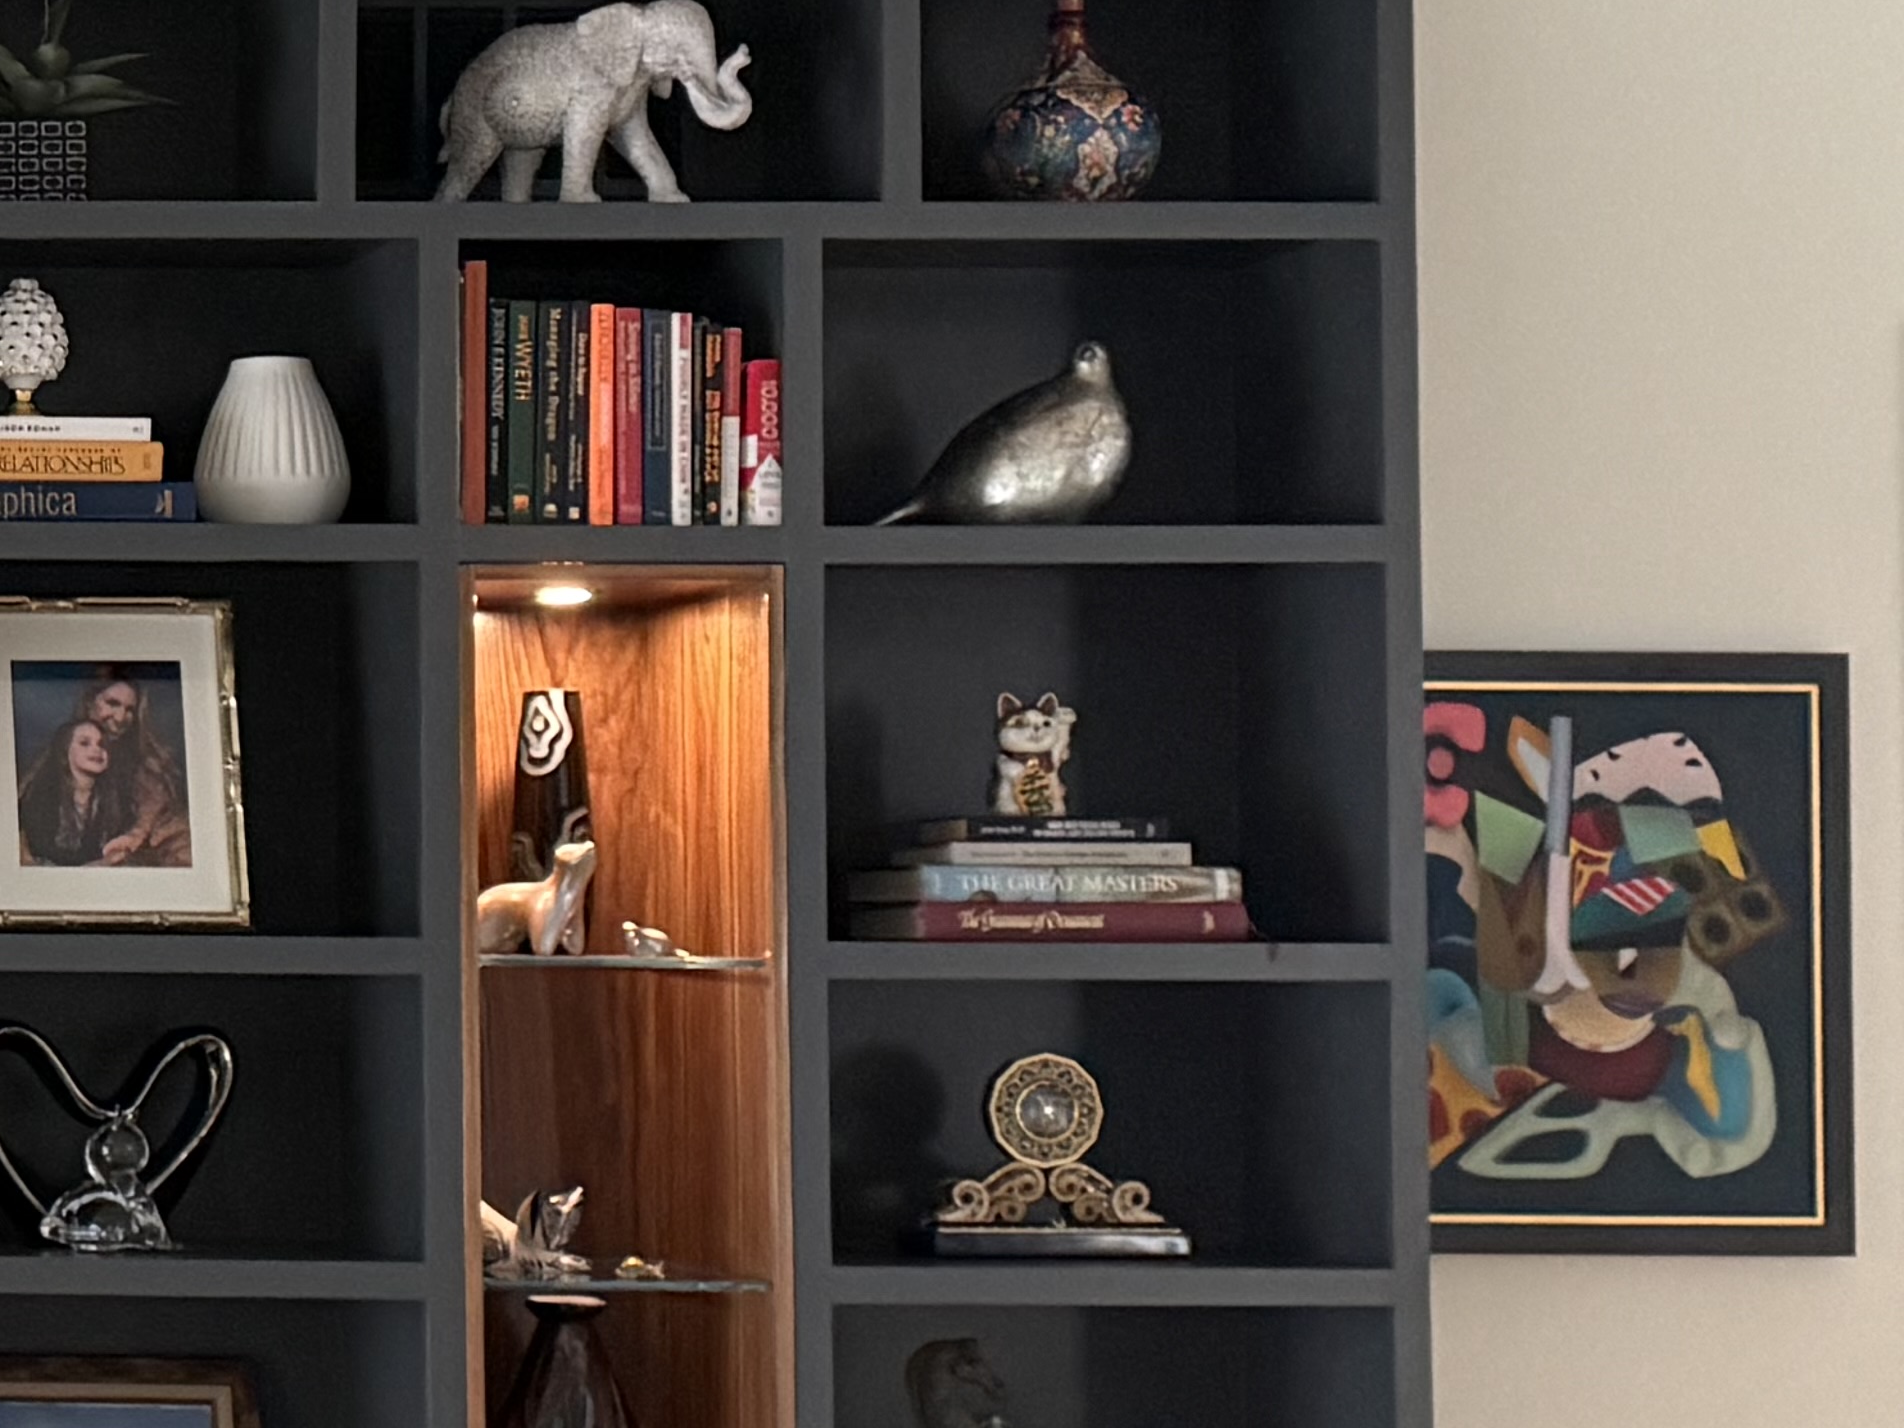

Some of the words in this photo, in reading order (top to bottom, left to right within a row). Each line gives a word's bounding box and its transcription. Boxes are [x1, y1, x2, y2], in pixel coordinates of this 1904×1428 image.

[491, 307, 506, 344] JOHN
[545, 308, 562, 368] Managing
[490, 355, 505, 420] KENNEDY
[513, 341, 533, 401] WYETH
[548, 371, 561, 392] the
[545, 395, 560, 441] Dragon
[959, 874, 999, 892] THE
[1006, 874, 1075, 892] GREAT
[1081, 875, 1179, 892] MASTERS
